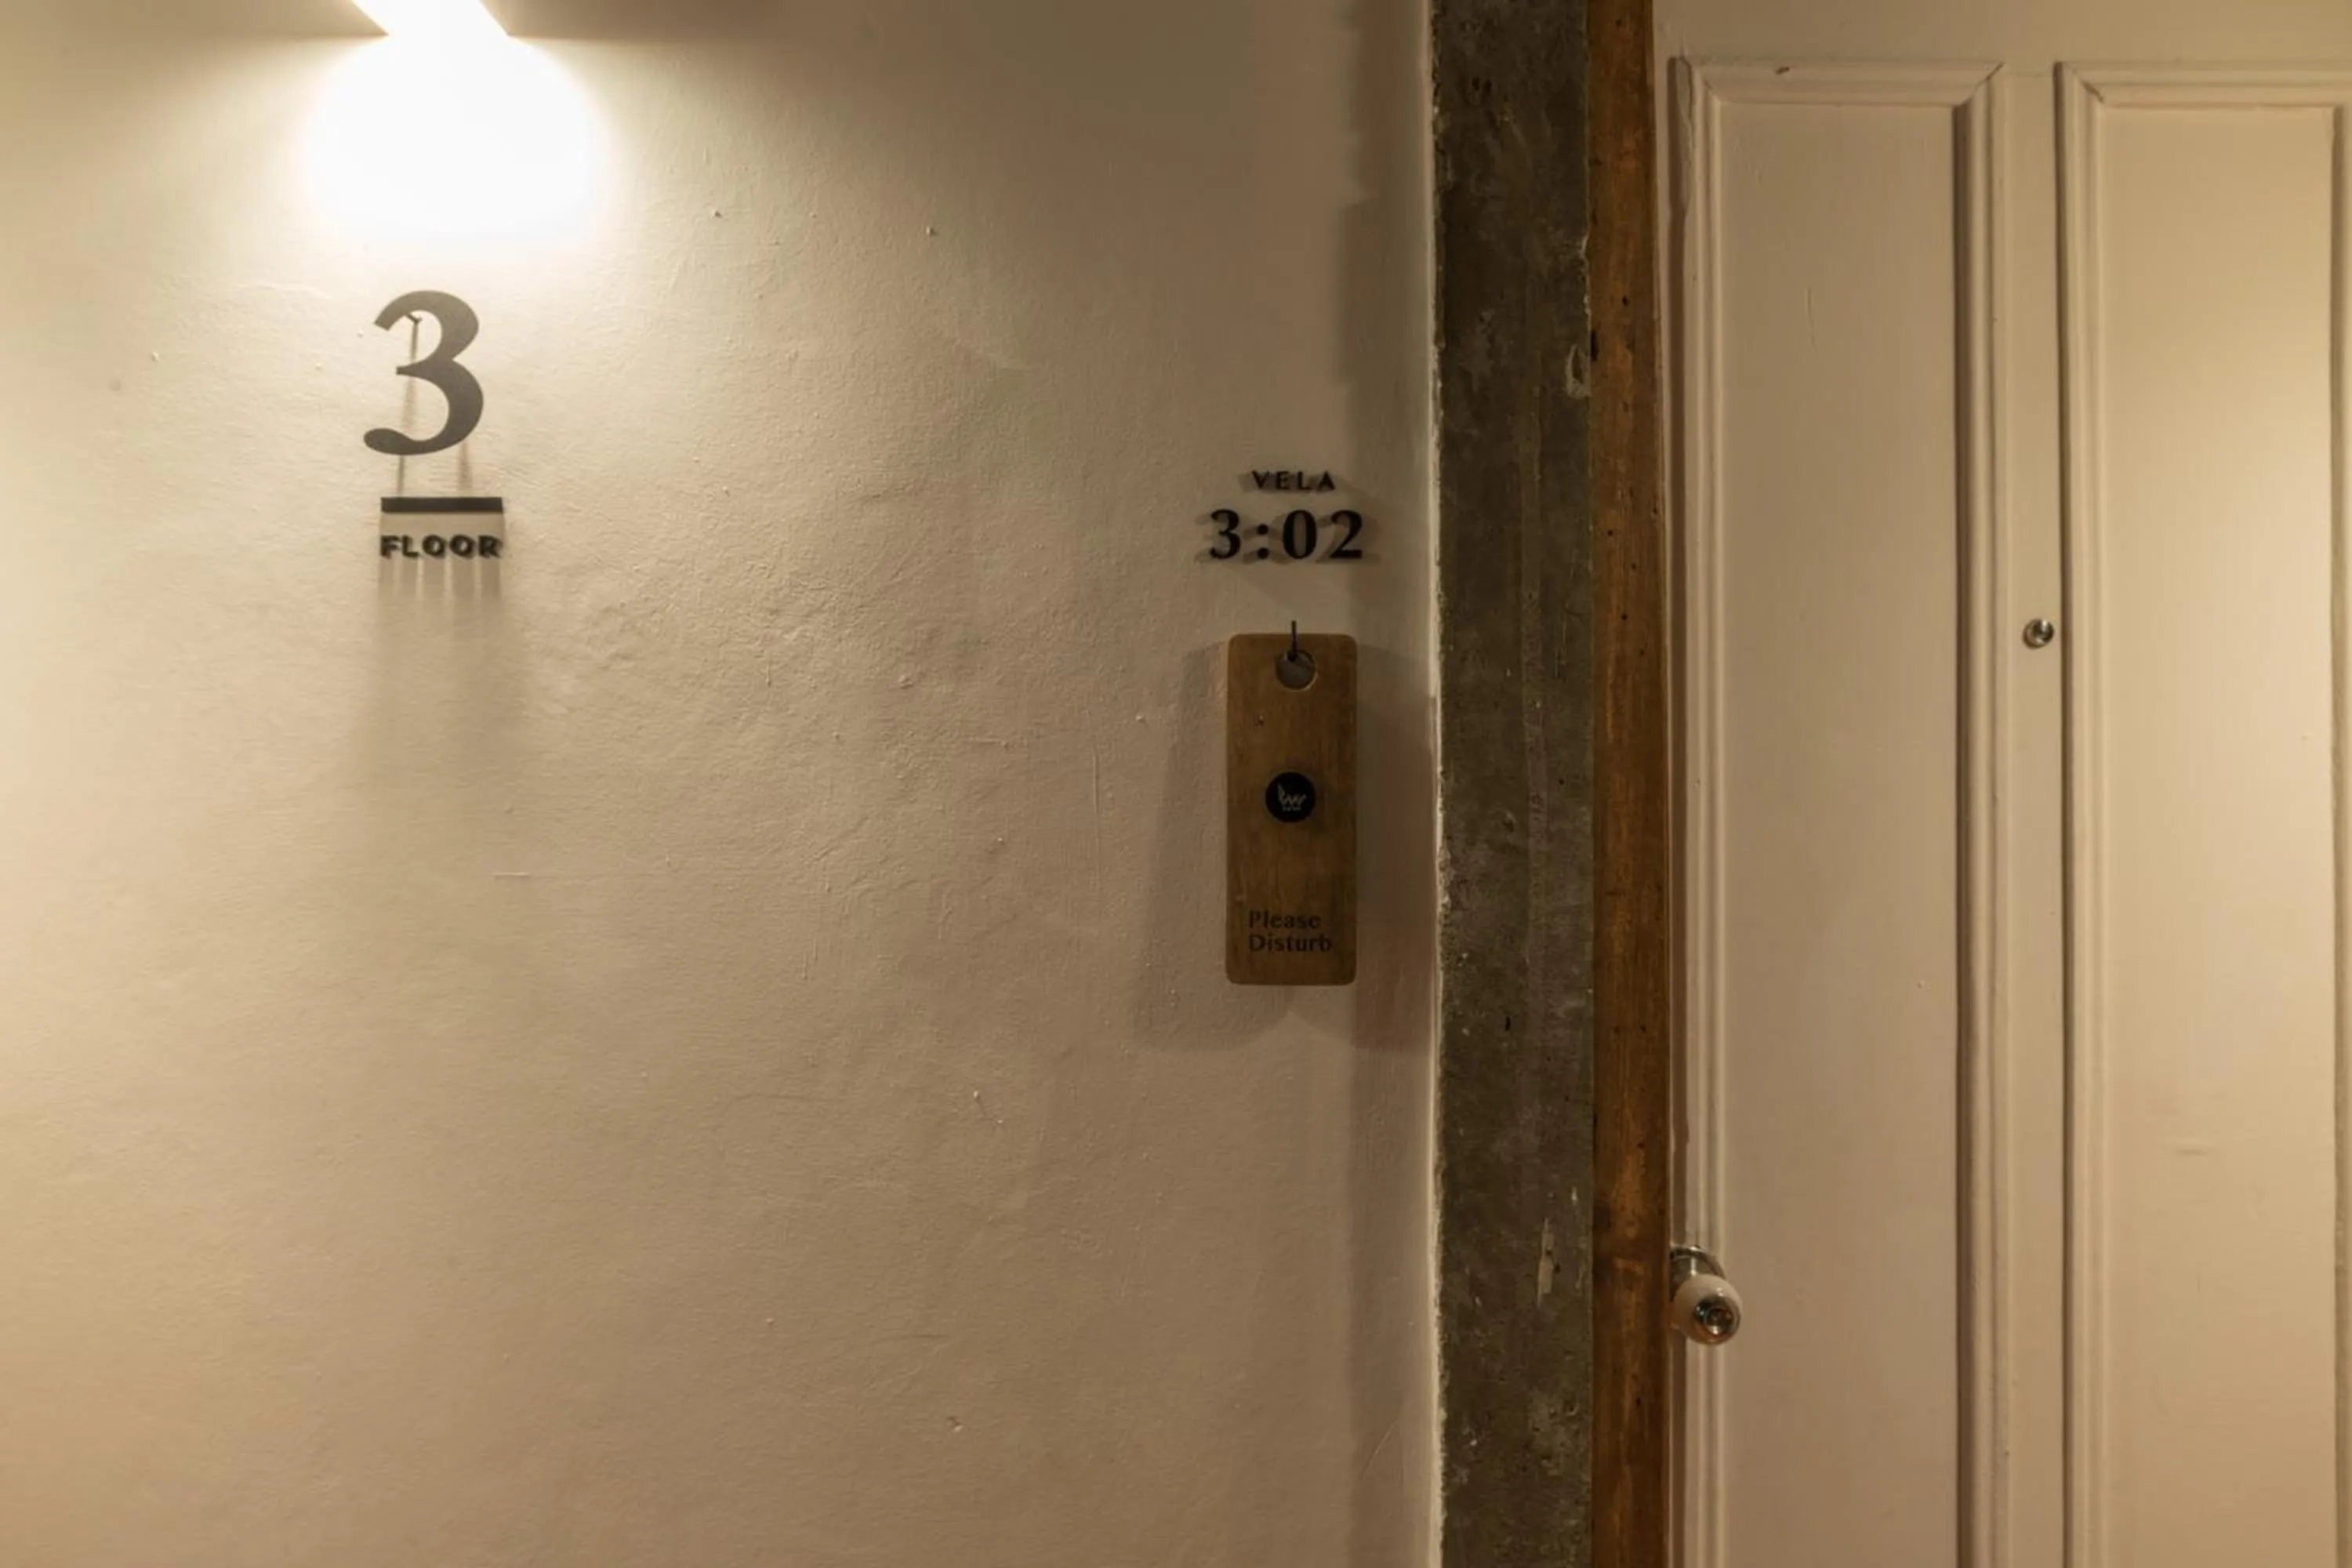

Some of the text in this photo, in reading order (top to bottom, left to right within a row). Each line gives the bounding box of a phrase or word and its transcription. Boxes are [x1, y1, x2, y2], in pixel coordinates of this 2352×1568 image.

[363, 290, 484, 456] 3
[1252, 470, 1335, 490] VELA
[1210, 510, 1363, 559] 3:02
[380, 535, 502, 559] FLOOR
[1249, 910, 1321, 929] Please
[1248, 931, 1332, 953] Disturb
